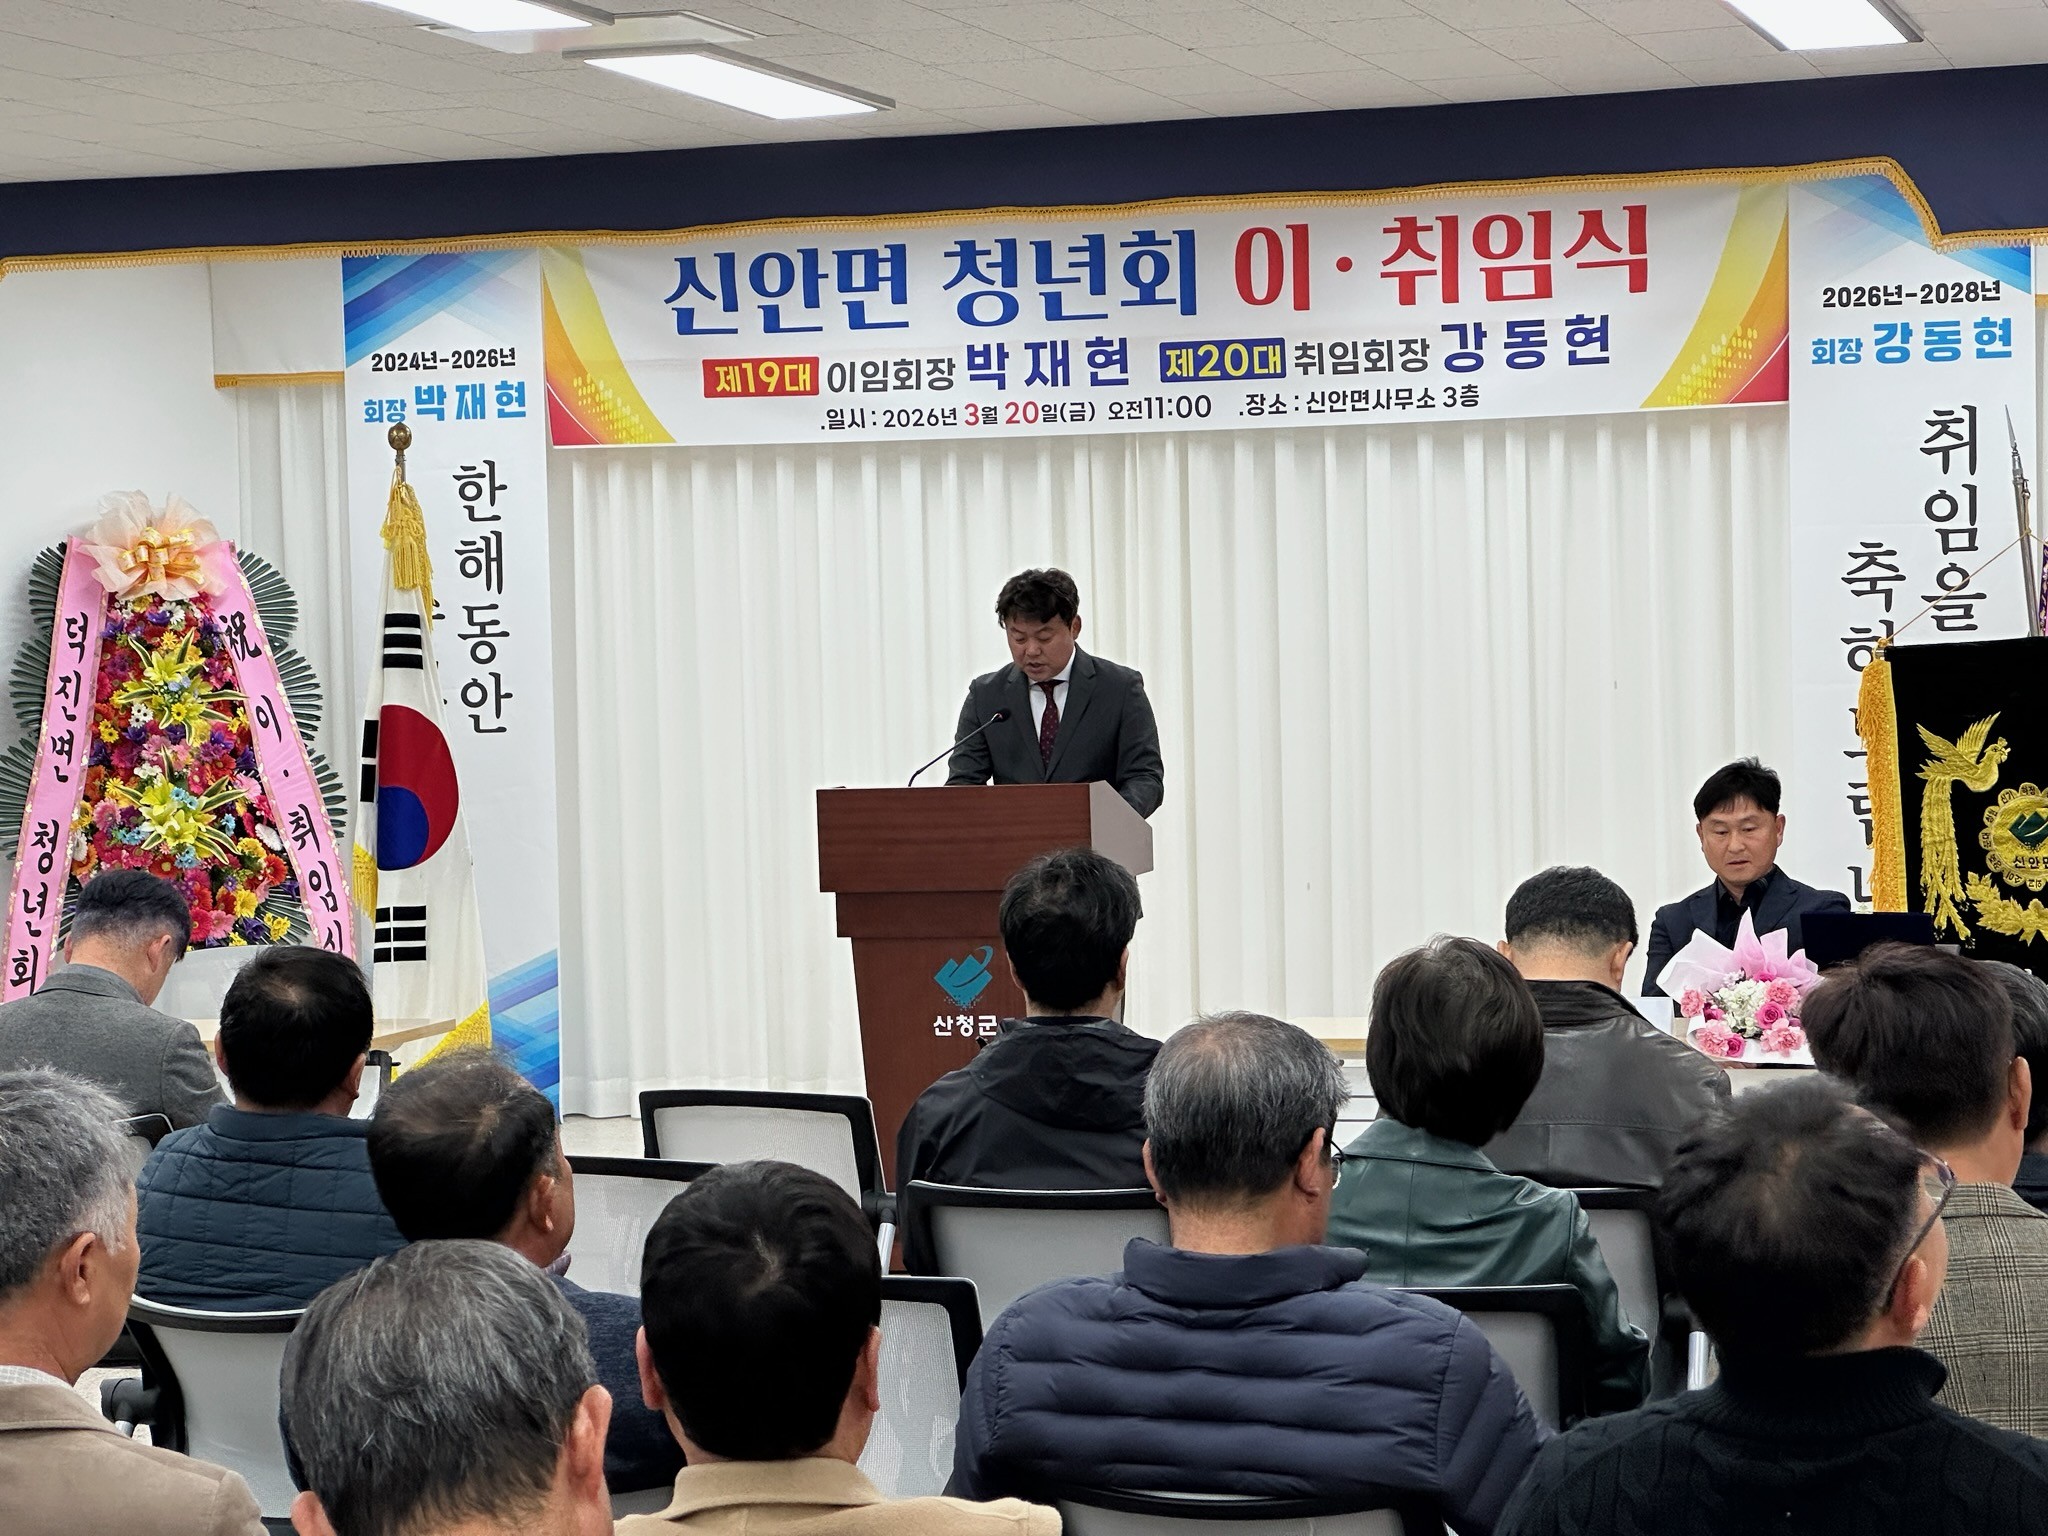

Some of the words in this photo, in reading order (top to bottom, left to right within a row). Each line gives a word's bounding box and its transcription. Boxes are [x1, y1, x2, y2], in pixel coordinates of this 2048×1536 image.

[664, 243, 910, 335] 신안면
[943, 228, 1198, 327] 청년회
[1822, 280, 2001, 308] 2026년-2028년
[371, 348, 516, 372] 2024년-2026년
[714, 361, 812, 394] 제19대
[826, 357, 956, 393] 이임회장
[1165, 342, 1282, 379] 제20대
[1294, 337, 1430, 376] 취임회장
[1811, 338, 1863, 365] 회장
[364, 399, 407, 423] 회장
[1305, 389, 1436, 414] 신안면사무소
[1443, 383, 1480, 408] 3층
[883, 407, 957, 428] 2026년
[964, 404, 998, 426] 3월
[1005, 400, 1096, 425] 20일(금)
[1919, 404, 1987, 632] 취임을
[219, 610, 262, 662] 祝
[10, 819, 60, 996] 청년회
[933, 1014, 998, 1038] 산청군
